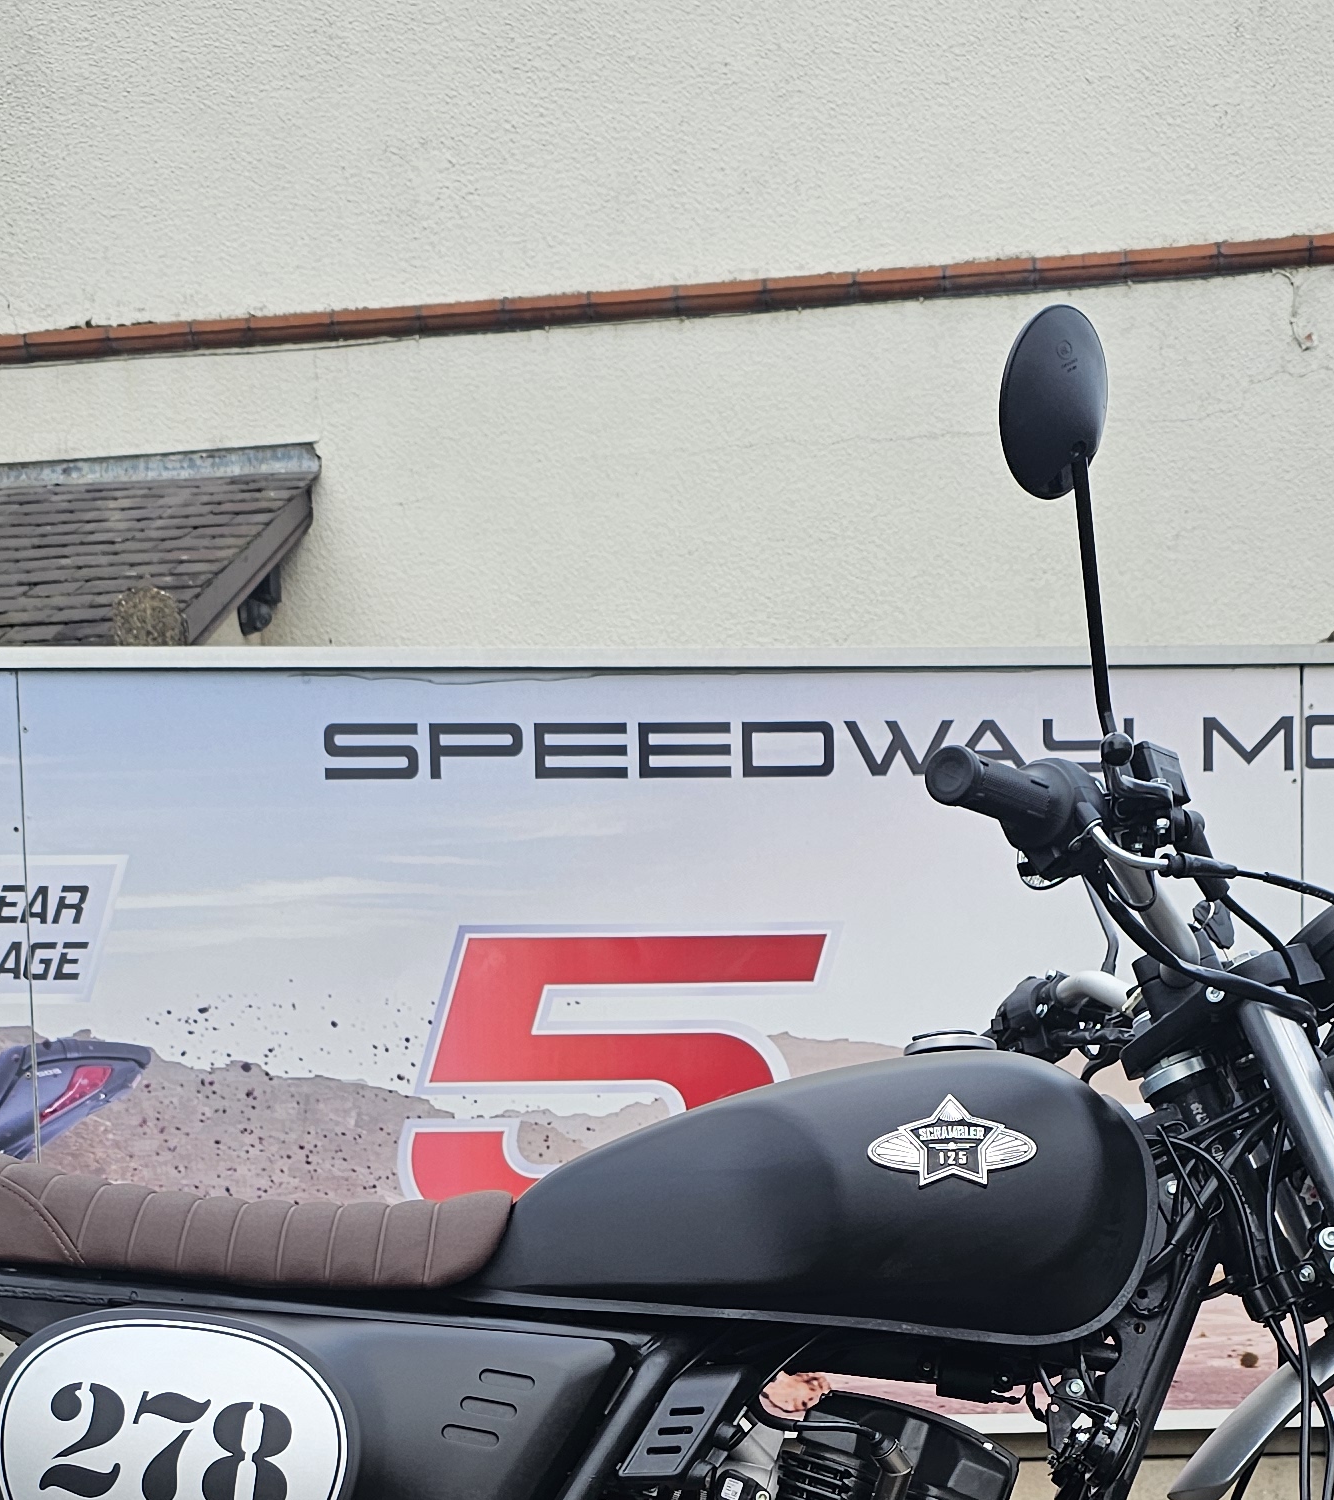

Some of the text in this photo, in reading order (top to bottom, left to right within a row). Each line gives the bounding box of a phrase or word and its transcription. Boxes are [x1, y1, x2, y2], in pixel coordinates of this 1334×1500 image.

[323, 718, 1135, 781] SPEEDWAY
[407, 930, 832, 1205] 5
[919, 1126, 985, 1140] SCRAMBLER
[938, 1151, 968, 1165] 125
